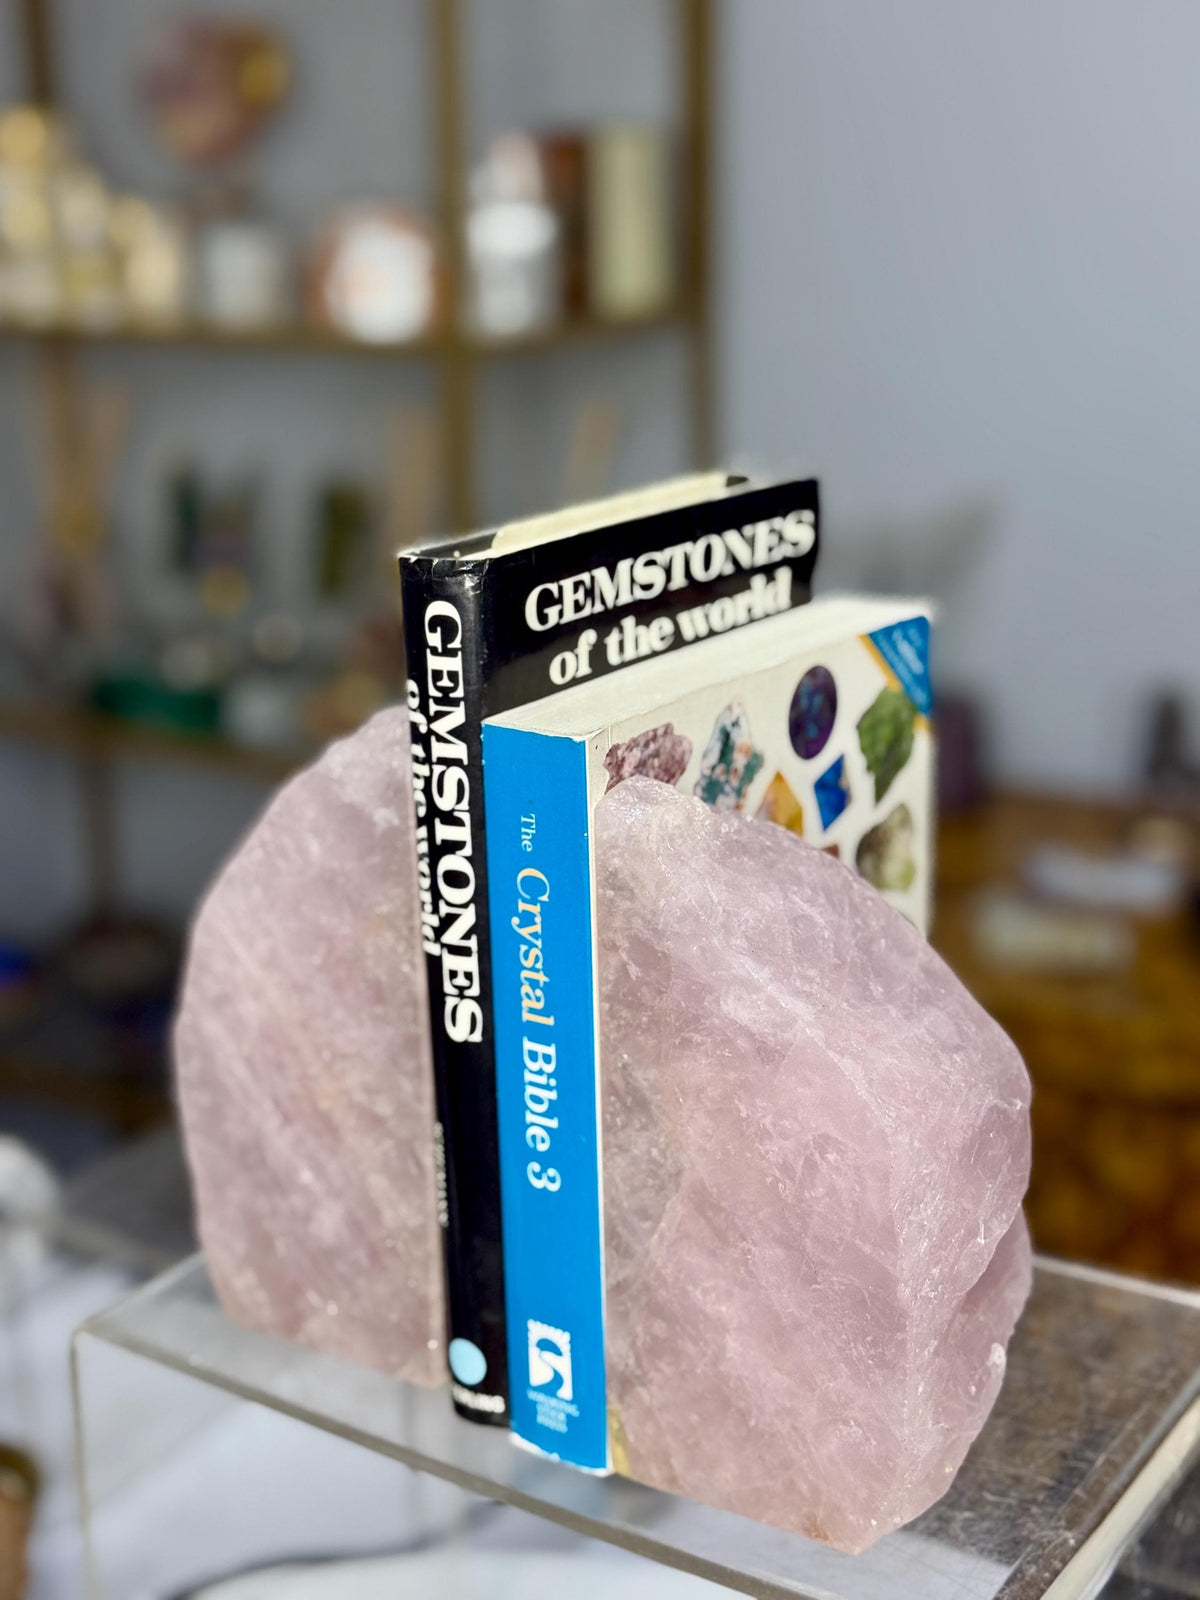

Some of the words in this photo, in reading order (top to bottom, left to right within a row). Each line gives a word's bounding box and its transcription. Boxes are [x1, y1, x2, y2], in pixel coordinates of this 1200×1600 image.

[524, 509, 815, 632] GEMSTONES
[549, 628, 597, 686] of
[604, 615, 675, 666] the
[675, 566, 793, 643] world
[406, 679, 428, 734] of
[411, 743, 431, 818] the
[424, 600, 483, 1043] GEMSTONES
[520, 813, 536, 852] The
[416, 824, 442, 956] world
[511, 868, 555, 1026] Crystal
[522, 1037, 559, 1152] Bible
[527, 1161, 562, 1192] 3
